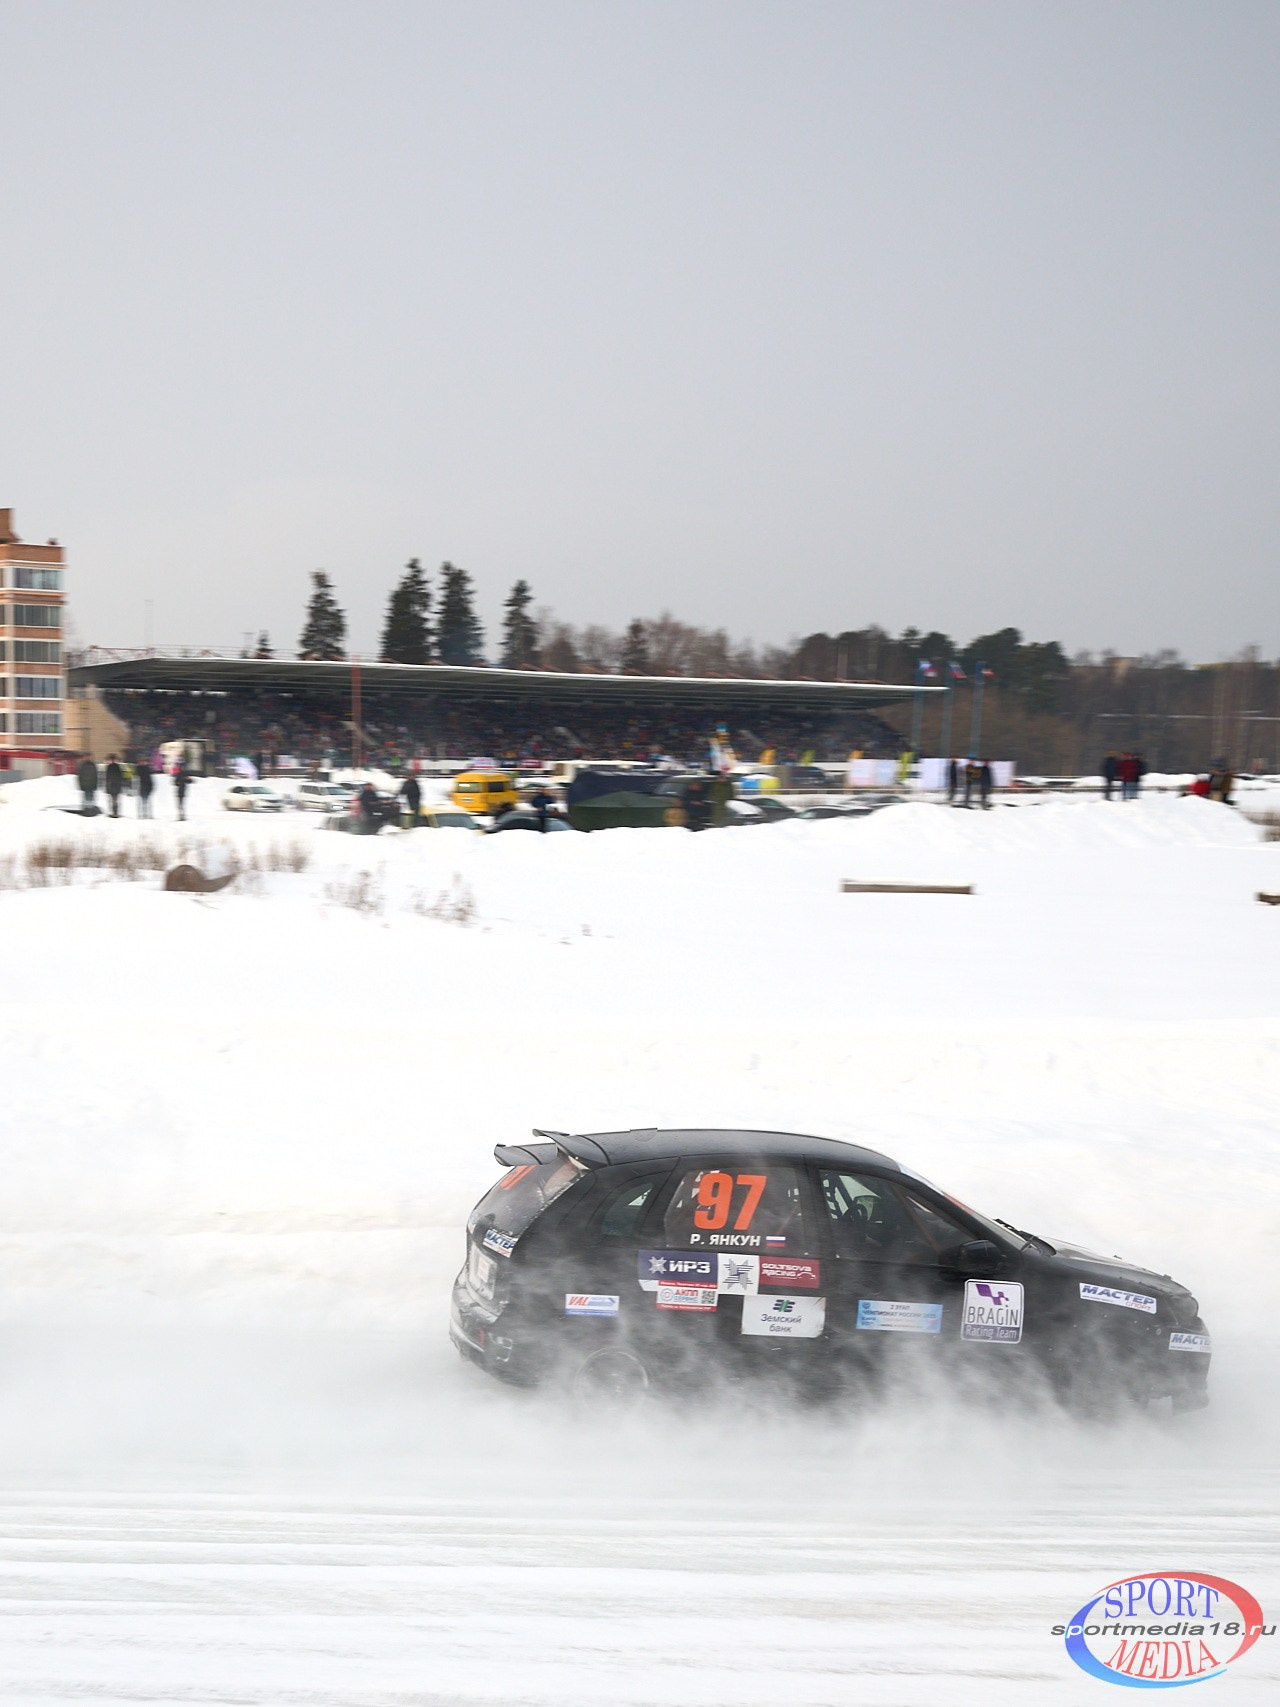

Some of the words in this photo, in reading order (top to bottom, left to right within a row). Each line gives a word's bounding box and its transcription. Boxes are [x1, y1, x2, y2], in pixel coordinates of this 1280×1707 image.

[694, 1172, 767, 1230] 97
[690, 1233, 705, 1245] Р.
[709, 1234, 761, 1246] ЯНКУН
[669, 1260, 711, 1274] ИРЗ
[1082, 1284, 1155, 1305] МАСТЕР
[761, 1313, 802, 1324] Земский
[769, 1324, 793, 1333] банк
[966, 1325, 993, 1339] Racing
[996, 1327, 1017, 1338] Team
